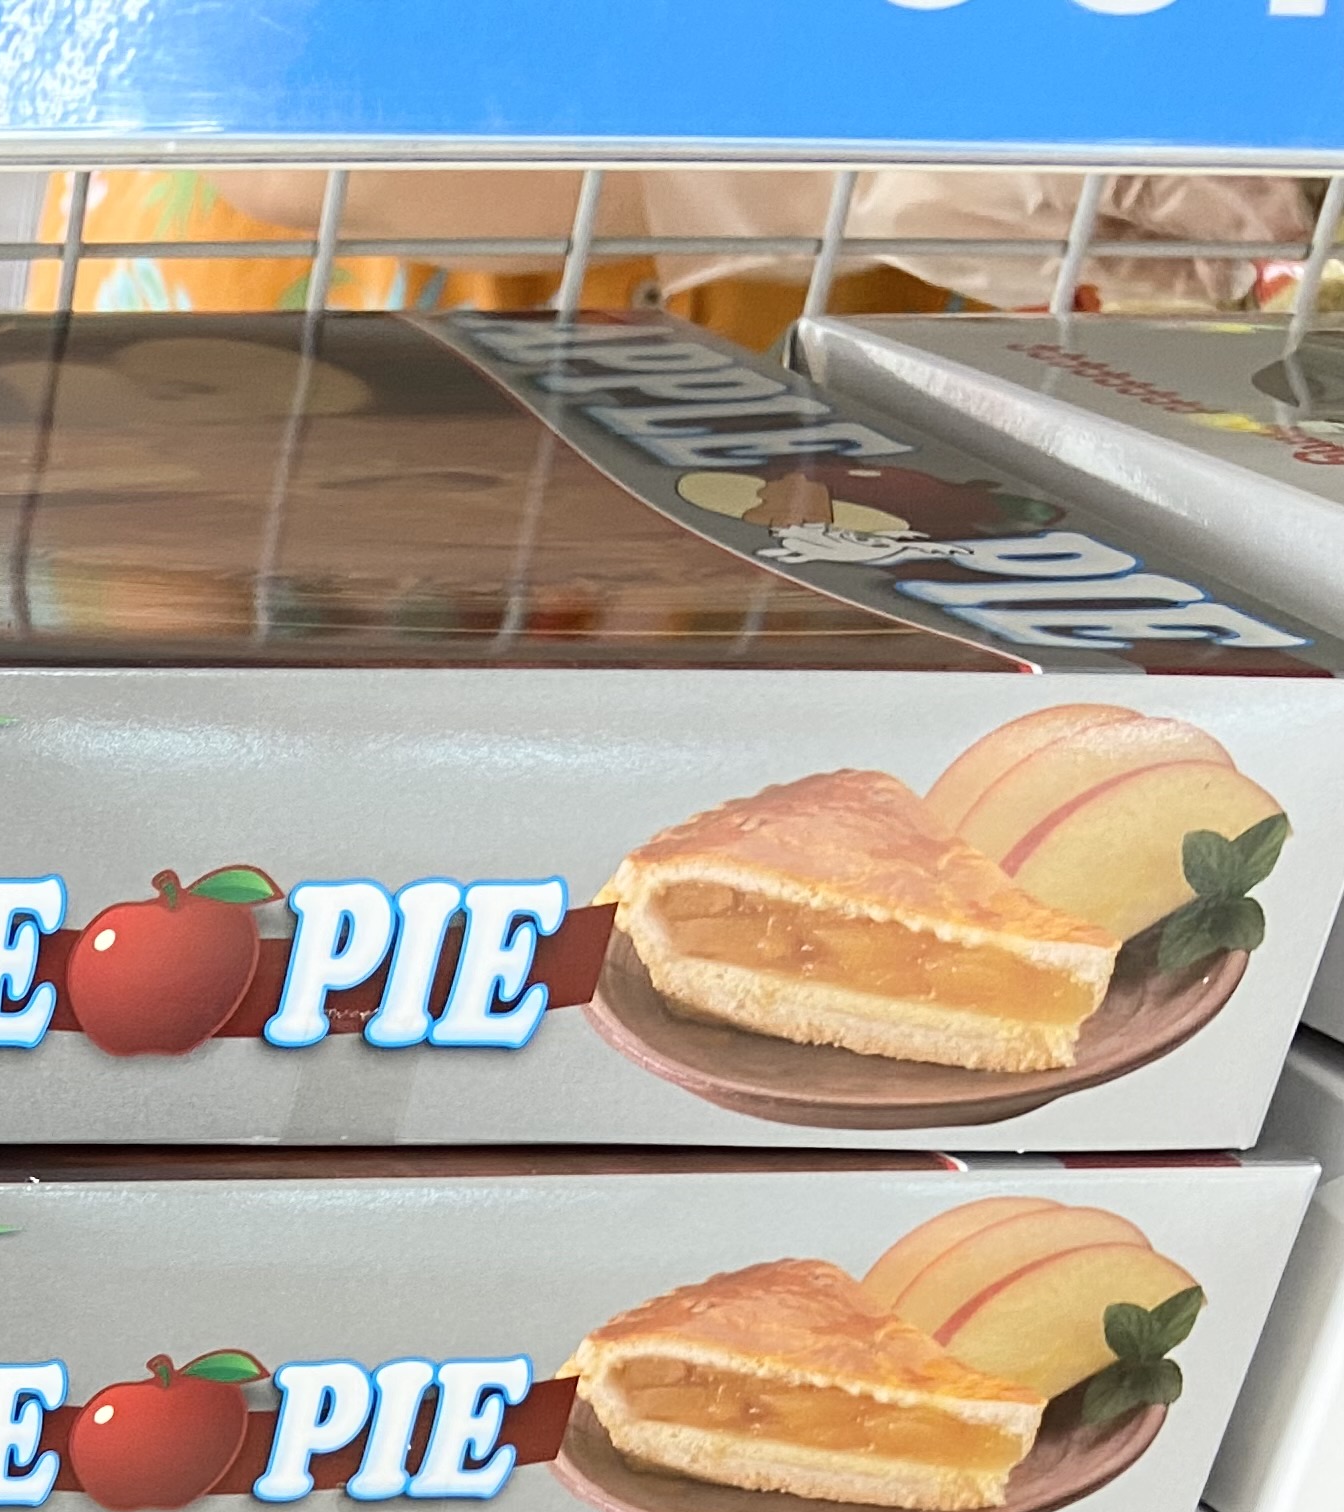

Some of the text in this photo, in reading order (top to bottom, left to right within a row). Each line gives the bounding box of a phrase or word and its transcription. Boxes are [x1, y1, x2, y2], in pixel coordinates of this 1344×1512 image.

[446, 310, 915, 467] APPLE
[893, 529, 1316, 651] PIE
[264, 876, 569, 1049] PIE
[252, 1353, 533, 1504] PIE
